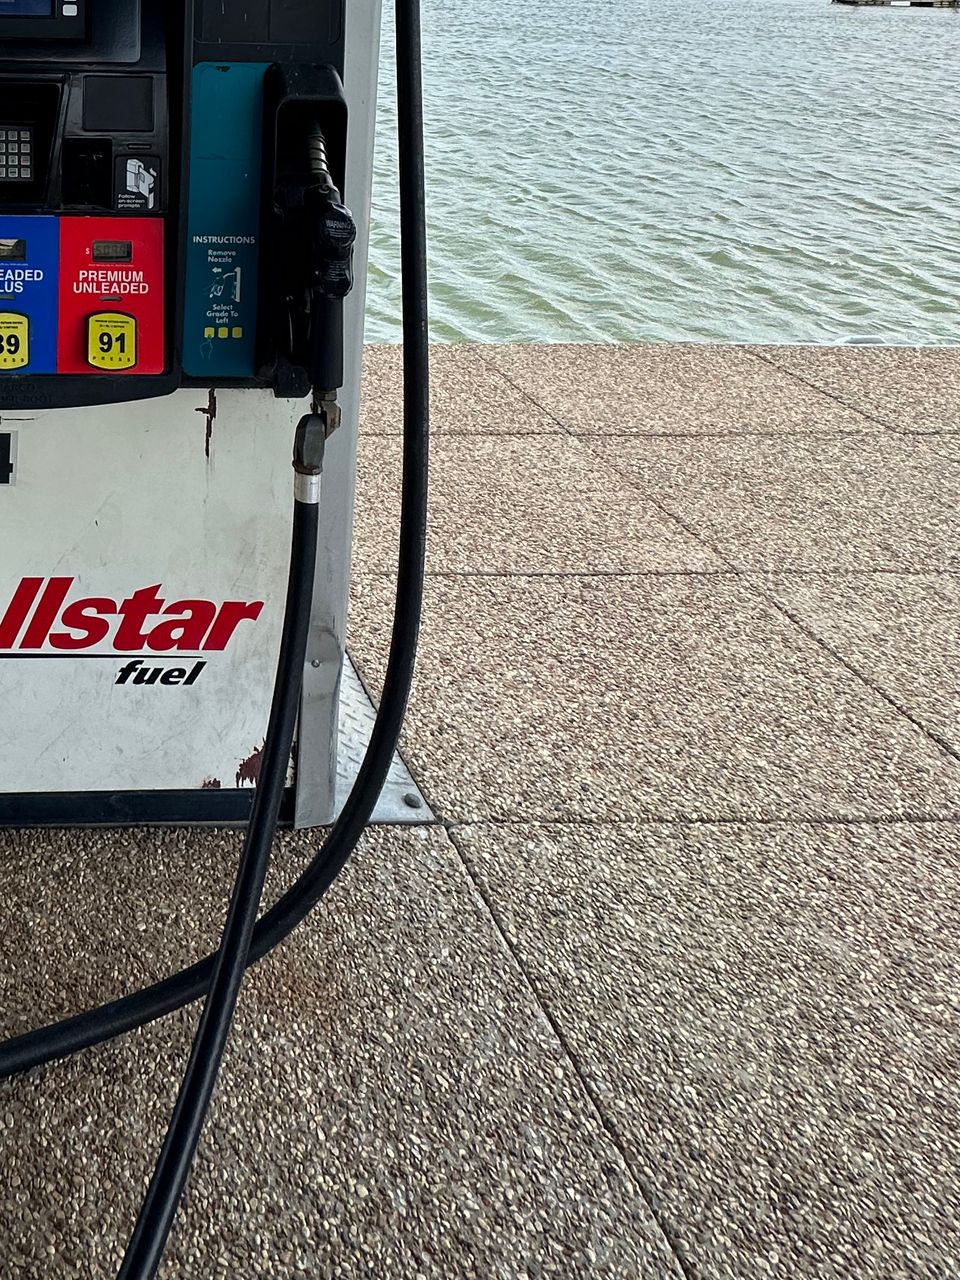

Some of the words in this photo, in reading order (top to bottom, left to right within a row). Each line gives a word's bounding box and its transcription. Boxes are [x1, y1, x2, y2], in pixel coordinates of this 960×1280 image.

[193, 236, 255, 244] INSTRUCTIONS
[79, 270, 143, 282] PREMIUM
[73, 282, 149, 294] UNLEADED
[99, 332, 125, 353] 91
[114, 660, 207, 687] fuel
